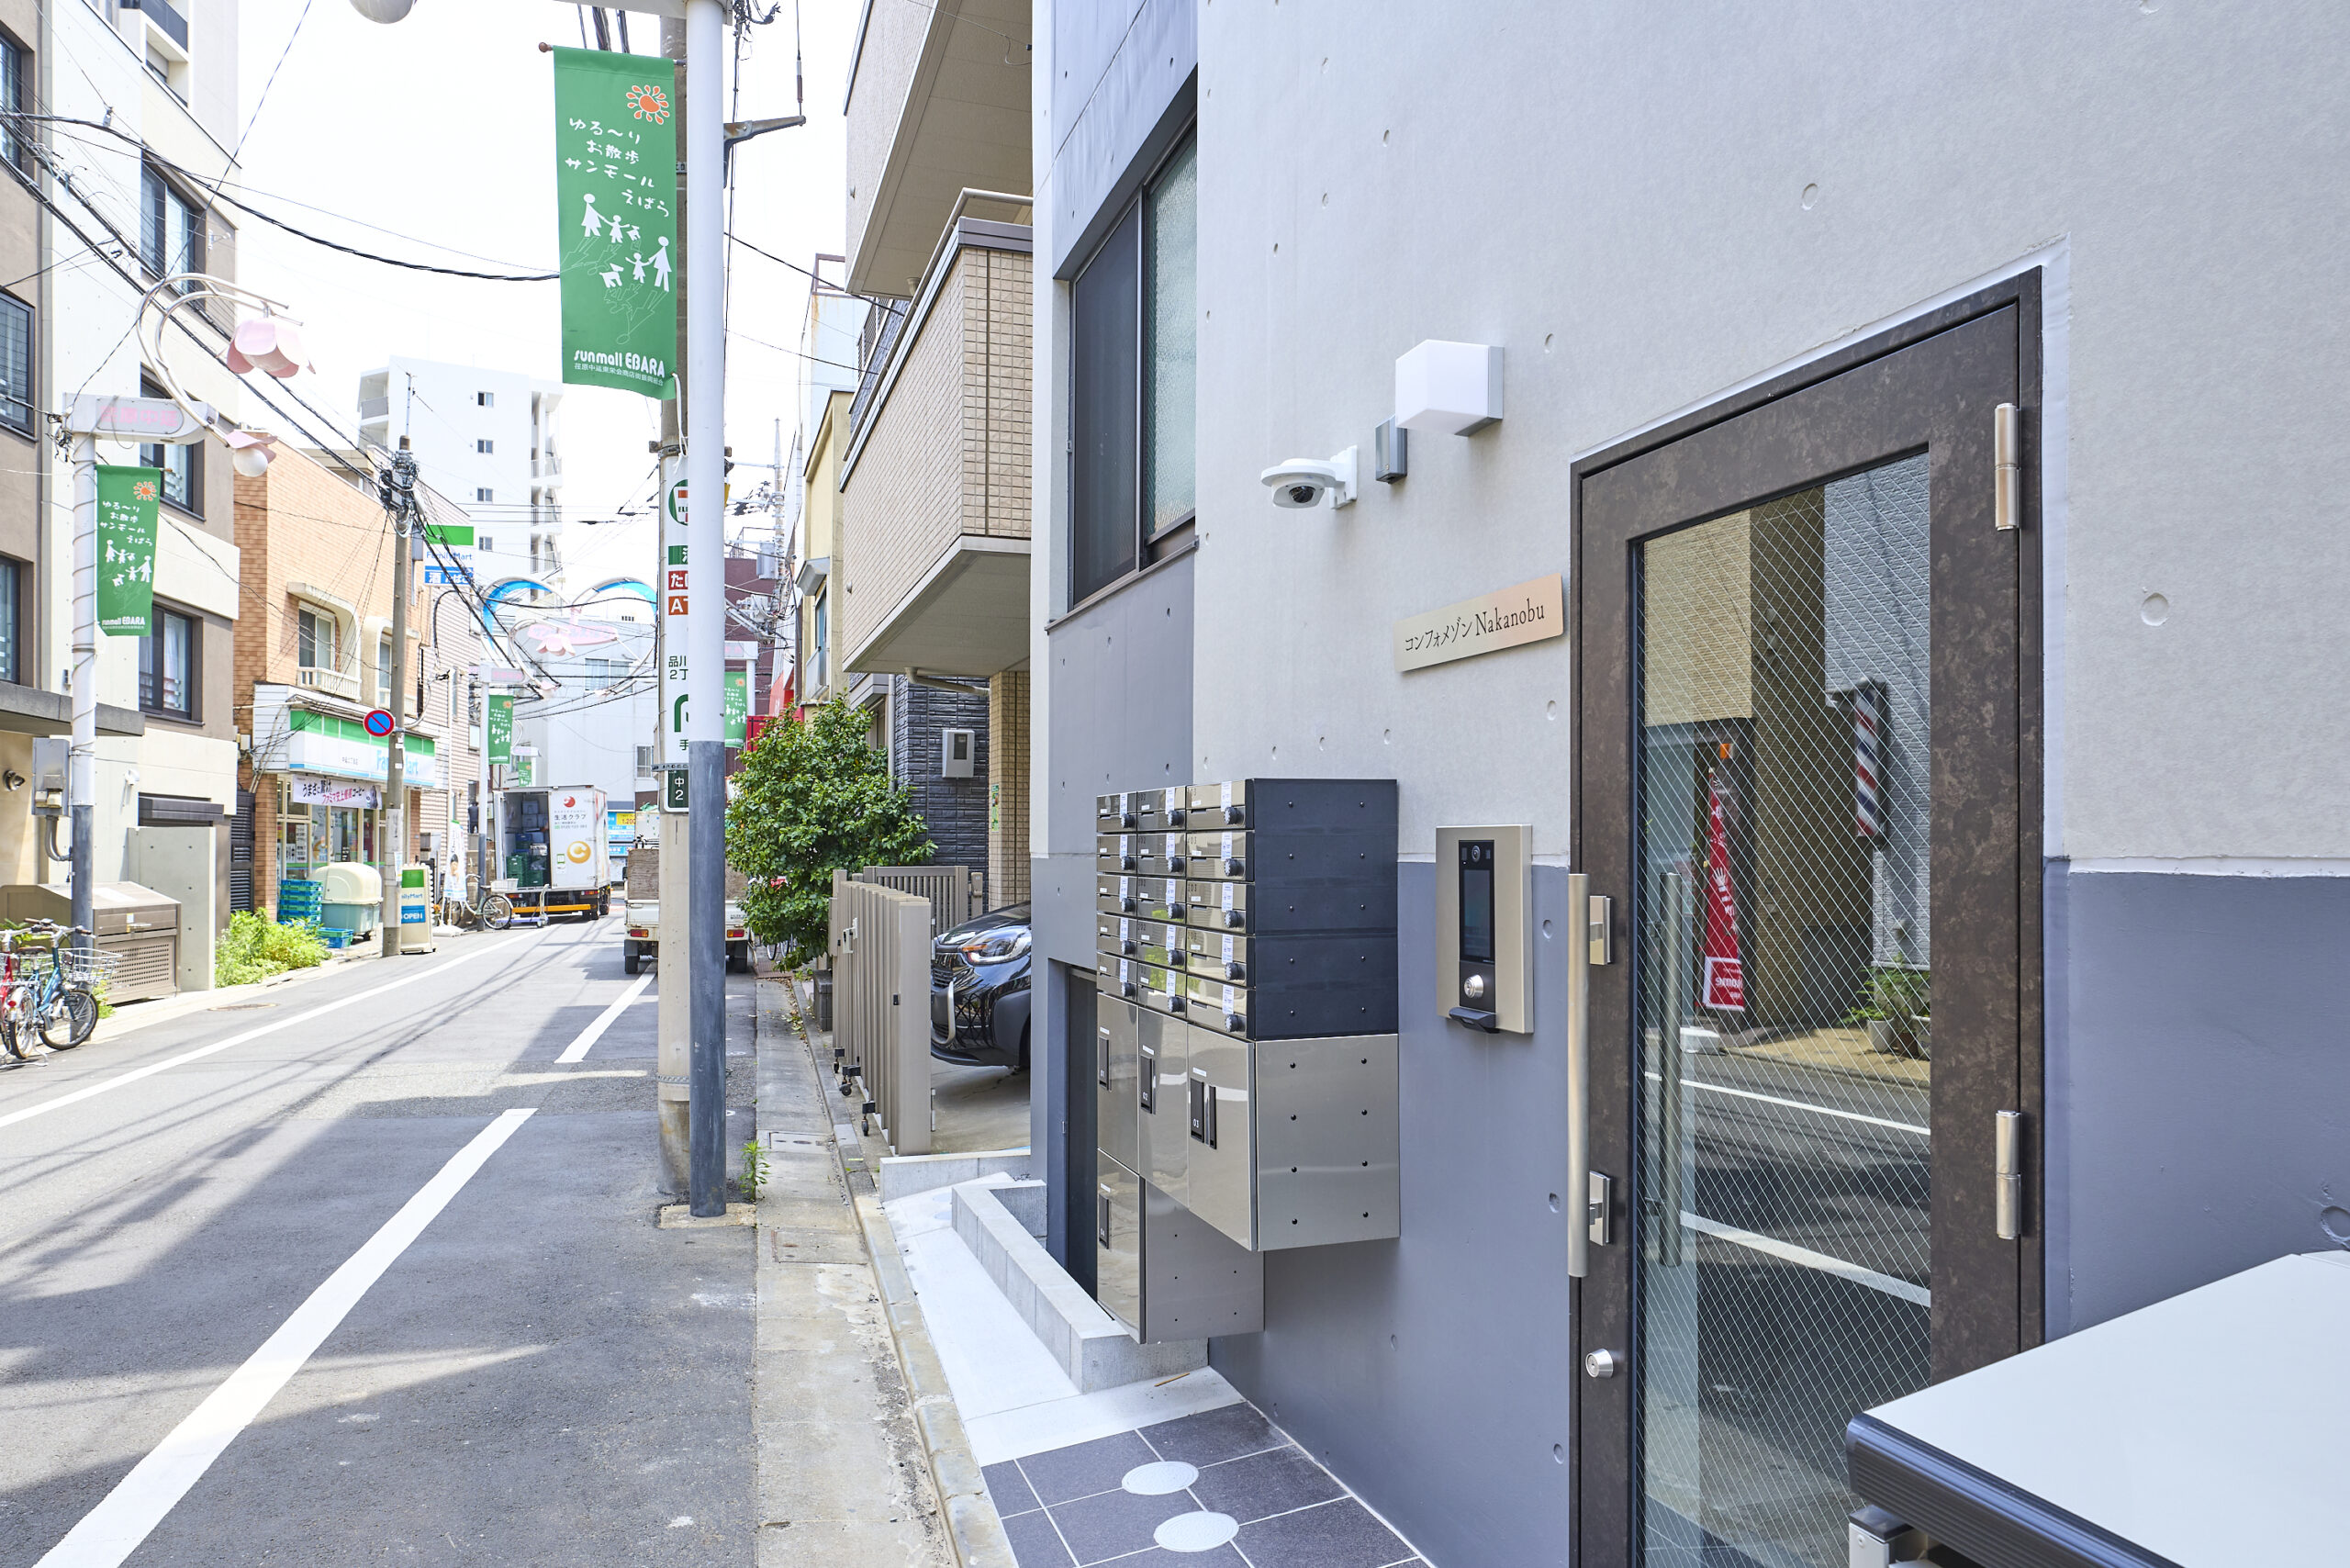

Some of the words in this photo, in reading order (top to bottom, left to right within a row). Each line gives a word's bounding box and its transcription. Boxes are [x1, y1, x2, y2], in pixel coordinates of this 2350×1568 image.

[586, 139, 640, 164] お散歩
[565, 157, 655, 188] サンモール
[621, 188, 669, 218] えばら
[574, 350, 623, 367] sunmall
[625, 353, 666, 378] EBARA
[99, 521, 145, 533] サンモール
[127, 534, 152, 546] えばら
[429, 572, 442, 584] 酒
[1405, 617, 1472, 651] コンフォメゾン
[1475, 599, 1545, 636] Nakanobu
[1142, 1092, 1148, 1101] 02
[1192, 1118, 1200, 1128] 03
